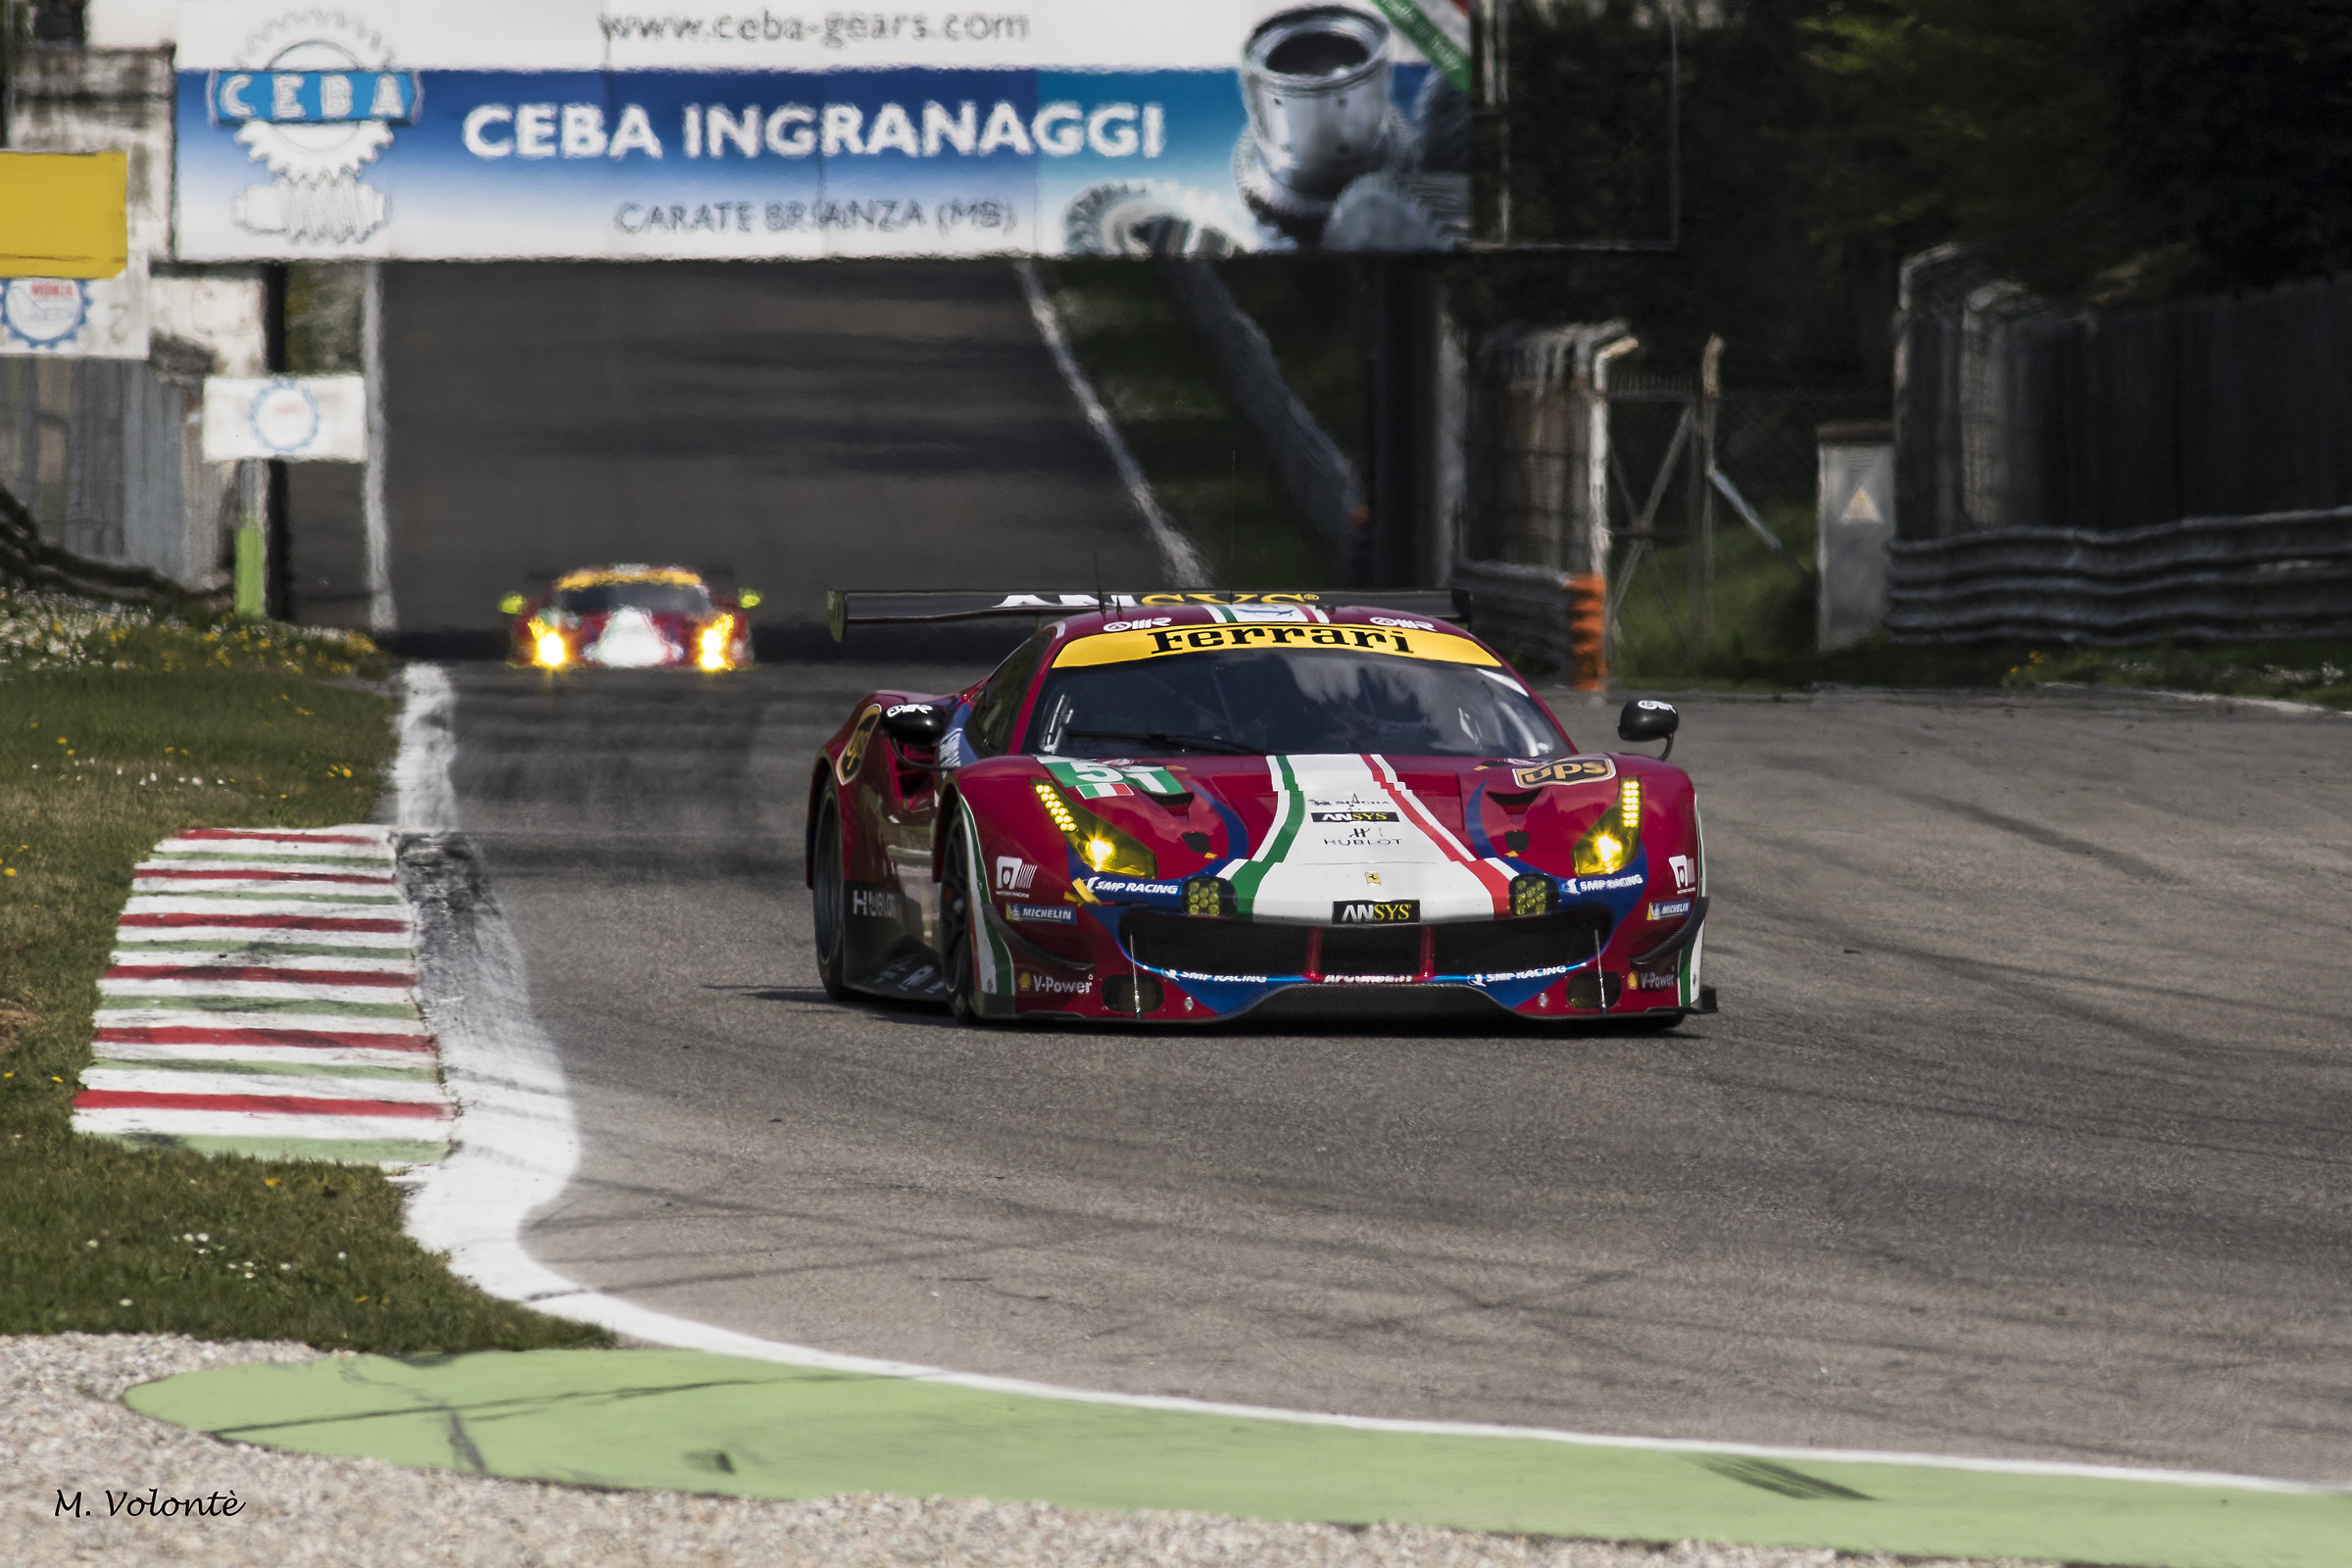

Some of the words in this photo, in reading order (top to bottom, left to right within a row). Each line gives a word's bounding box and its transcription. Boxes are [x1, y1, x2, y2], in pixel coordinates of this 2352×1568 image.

[598, 9, 1030, 48] www.ceba-gears.com
[220, 74, 405, 118] CEBA
[463, 102, 663, 160] CEBA
[682, 101, 1167, 160] INGRANAGGI
[613, 201, 755, 235] CARATE
[764, 199, 926, 234] BRIANZA
[1147, 626, 1415, 655] Ferrari
[1069, 762, 1168, 793] 51
[1322, 812, 1388, 821] ANSYS
[1095, 880, 1126, 893] SMP
[1125, 882, 1179, 895] RACING
[1022, 907, 1072, 920] MICHELIN
[1341, 904, 1412, 922] ANSYS
[1660, 902, 1690, 915] MICHELIN
[1033, 974, 1094, 994] V-Power
